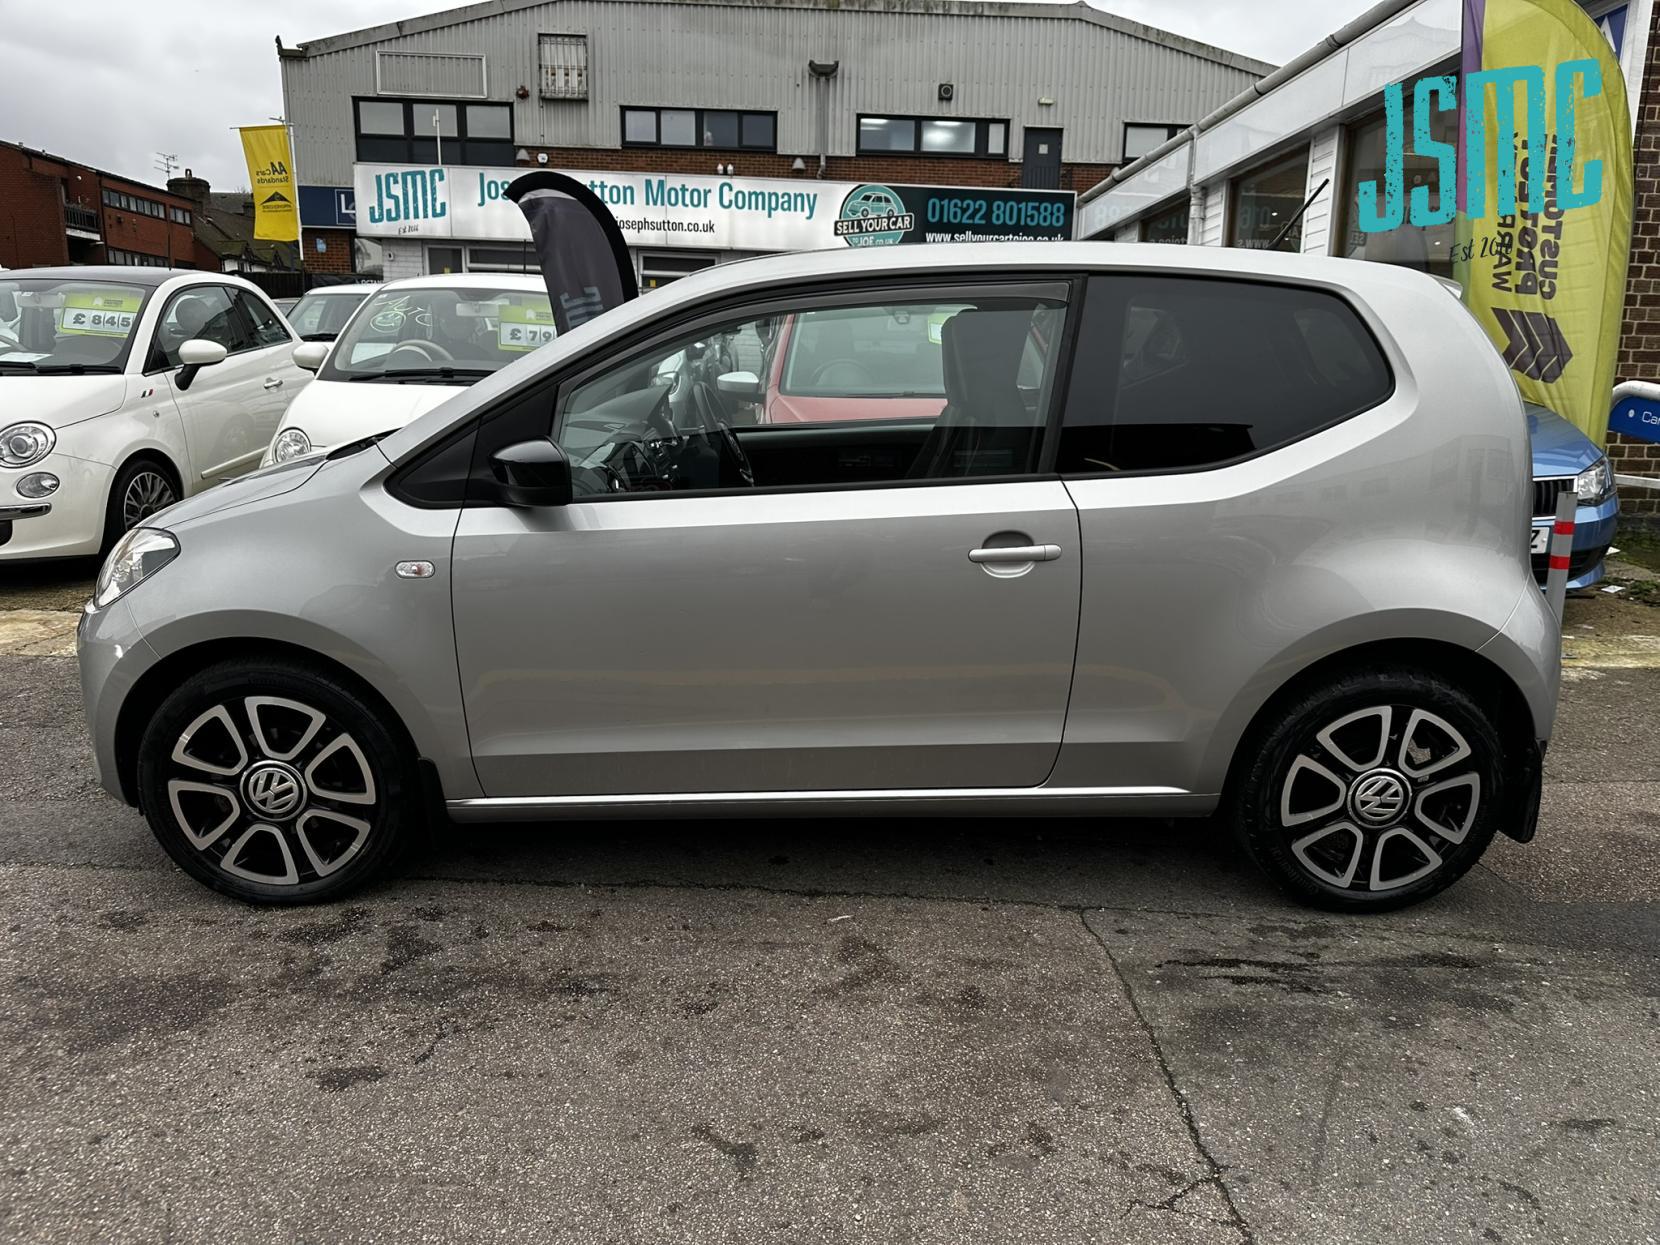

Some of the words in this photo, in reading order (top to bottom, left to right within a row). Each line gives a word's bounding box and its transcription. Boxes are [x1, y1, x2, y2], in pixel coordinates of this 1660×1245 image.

[369, 168, 447, 224] JSMC
[644, 178, 711, 208] Motor
[718, 182, 818, 220] Company
[927, 198, 987, 225] 01622
[991, 200, 1065, 227] 801588
[836, 221, 860, 235] SELL
[861, 218, 888, 232] YOUR
[889, 216, 911, 230] CAR
